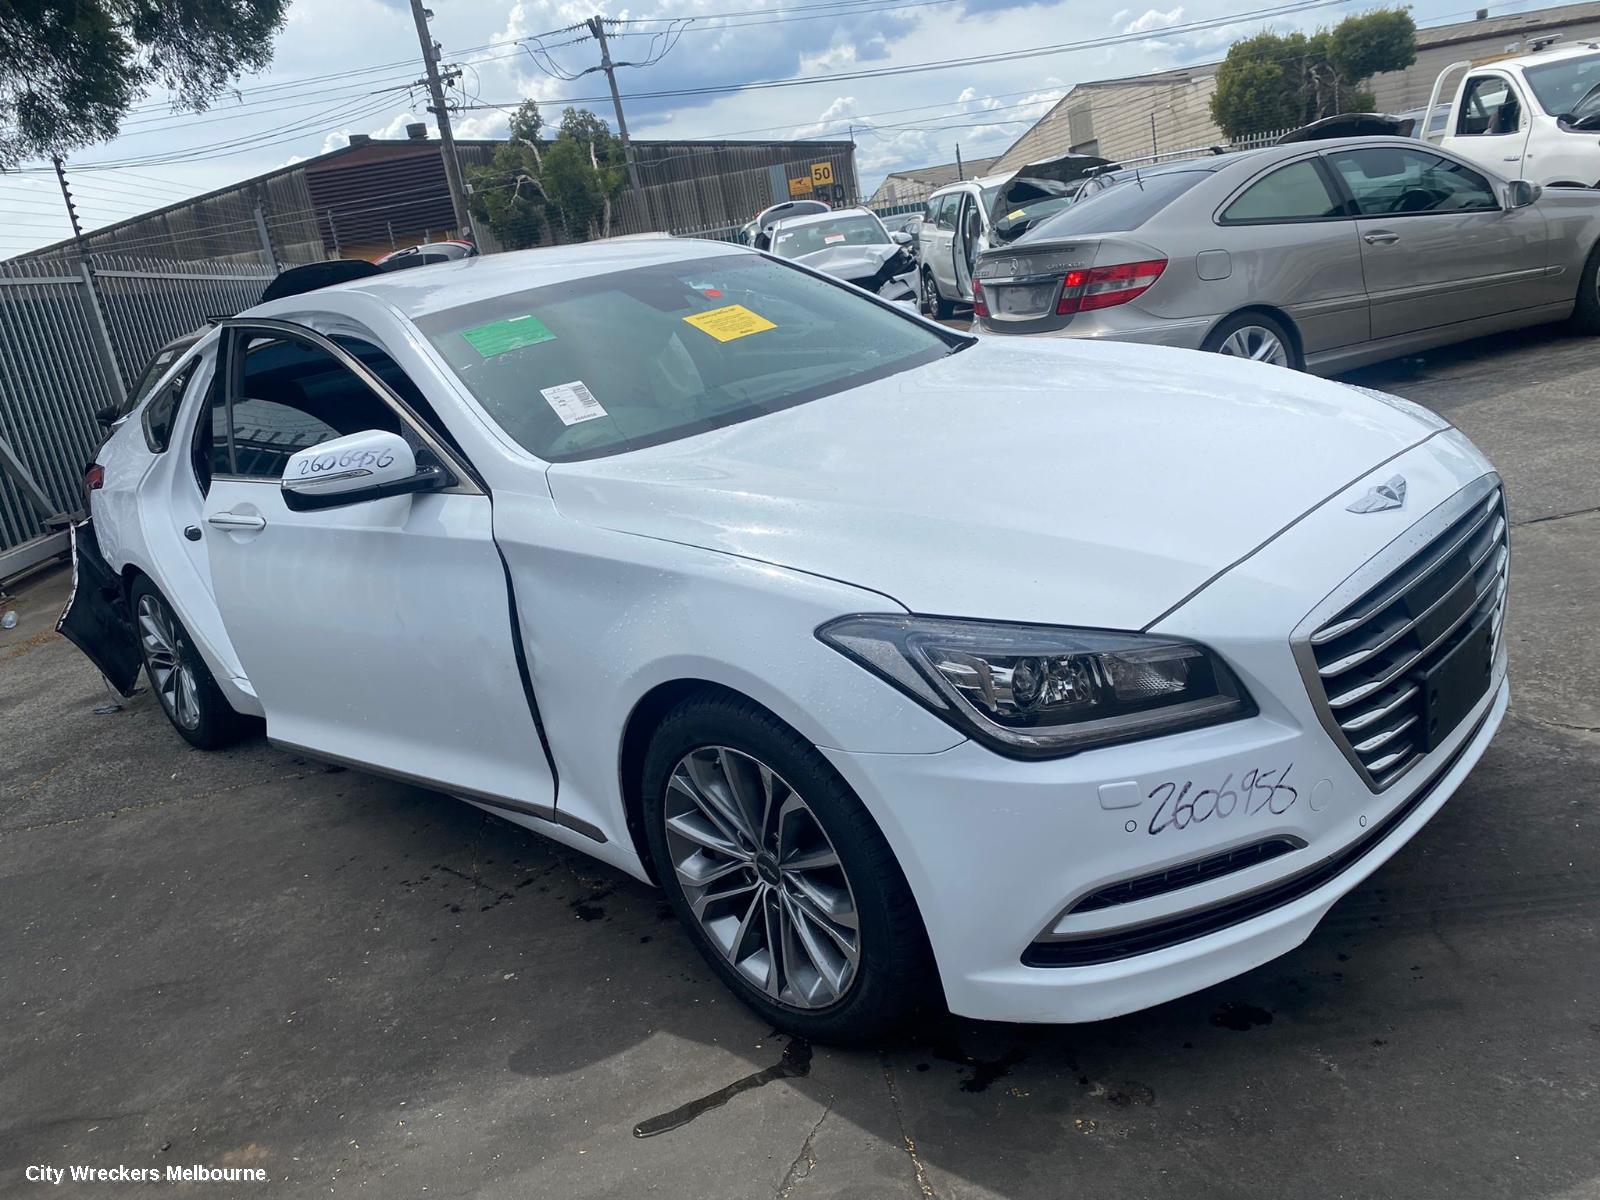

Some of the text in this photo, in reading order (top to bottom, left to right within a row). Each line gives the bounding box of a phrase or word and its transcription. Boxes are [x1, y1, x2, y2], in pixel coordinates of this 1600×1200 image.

[814, 167, 830, 181] 50
[298, 448, 394, 475] 2606956
[1148, 763, 1297, 835] 2606956
